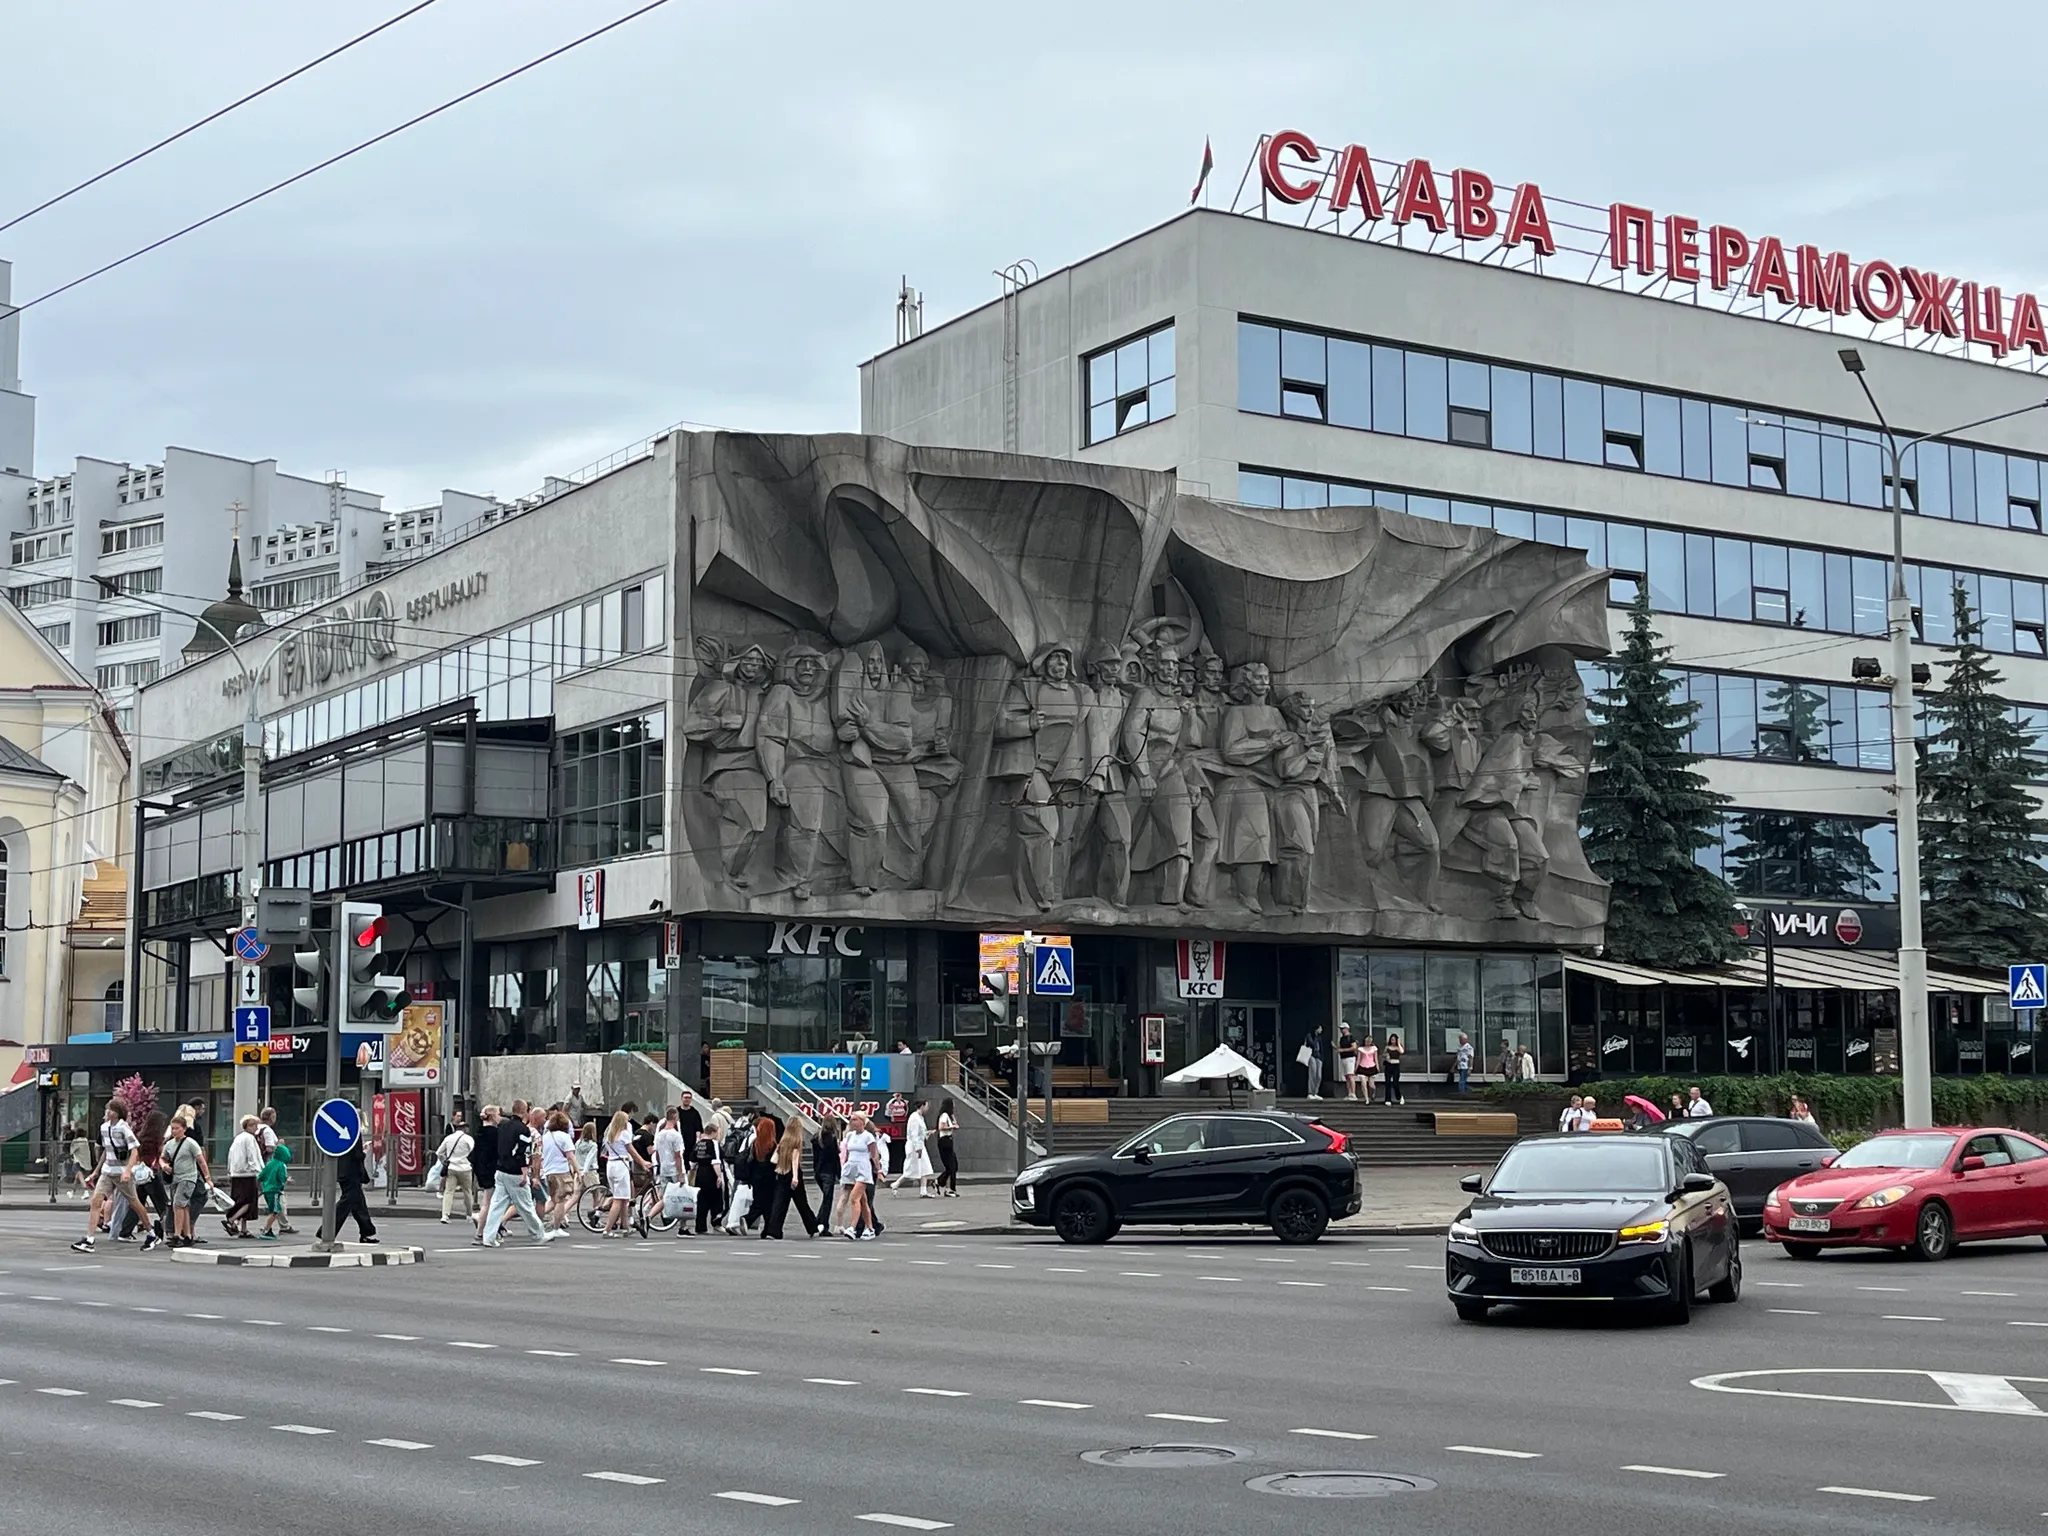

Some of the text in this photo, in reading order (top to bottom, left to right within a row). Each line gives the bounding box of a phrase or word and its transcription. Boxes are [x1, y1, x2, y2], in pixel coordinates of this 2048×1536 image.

[1259, 128, 2048, 359] СЛАВА ПЕРАМОЖЦА
[278, 590, 397, 698] FABRIQ
[767, 921, 864, 956] KFC
[1186, 982, 1217, 996] KFC
